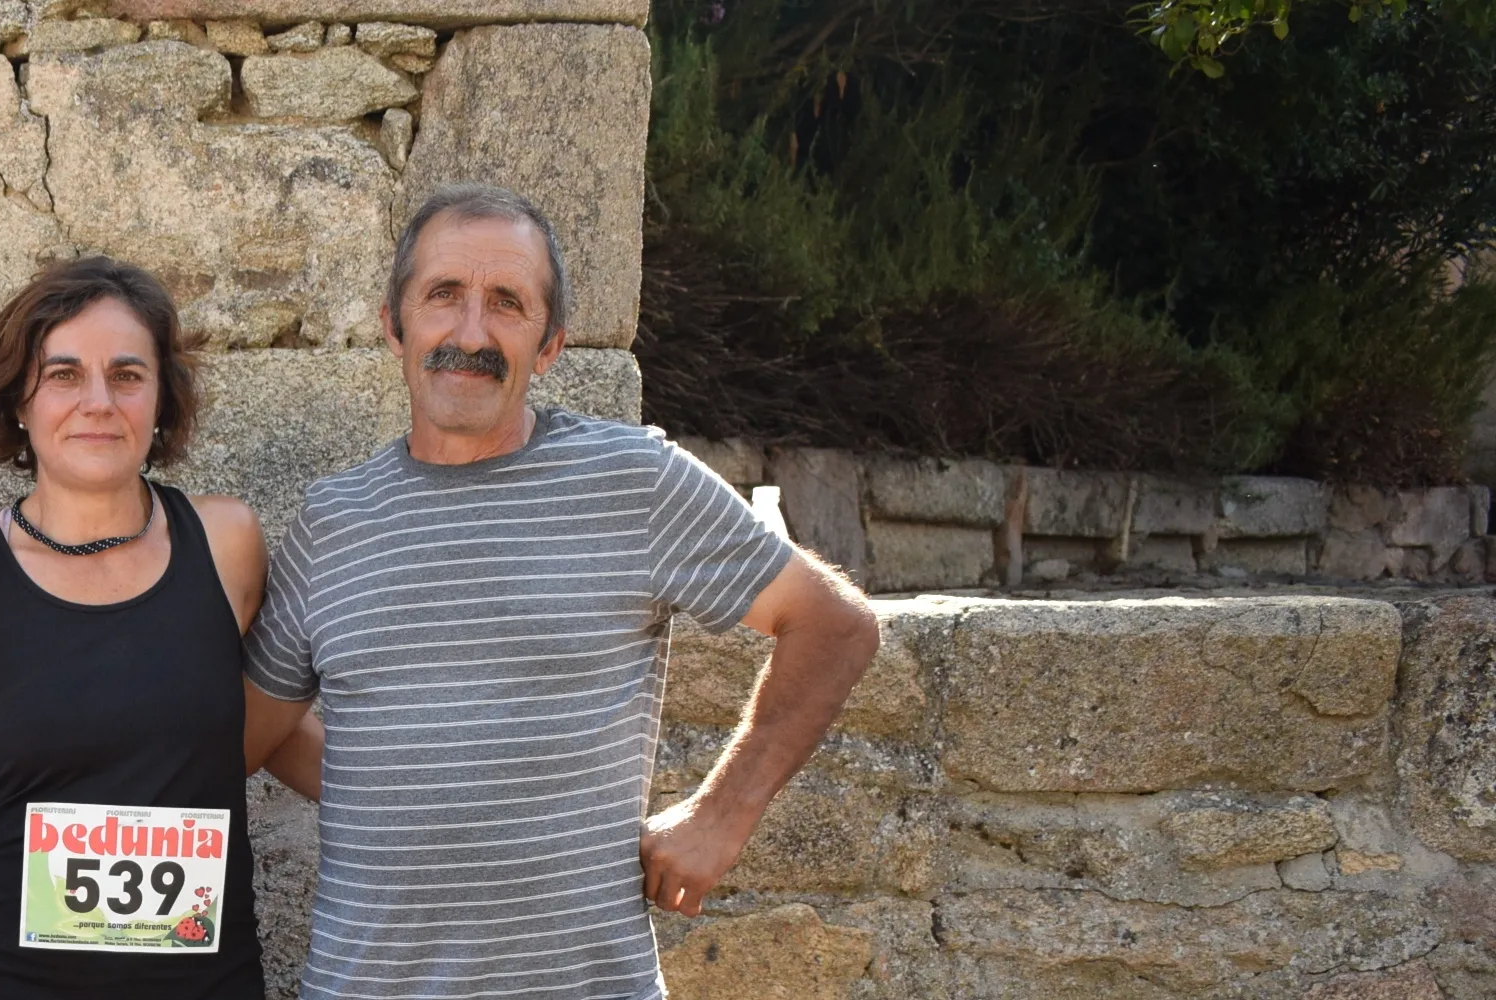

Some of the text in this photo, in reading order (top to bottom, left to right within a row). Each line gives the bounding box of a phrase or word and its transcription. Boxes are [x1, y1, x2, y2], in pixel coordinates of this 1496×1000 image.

[29, 813, 223, 859] bedunia
[64, 858, 185, 916] 539
[134, 922, 171, 930] diferentes
